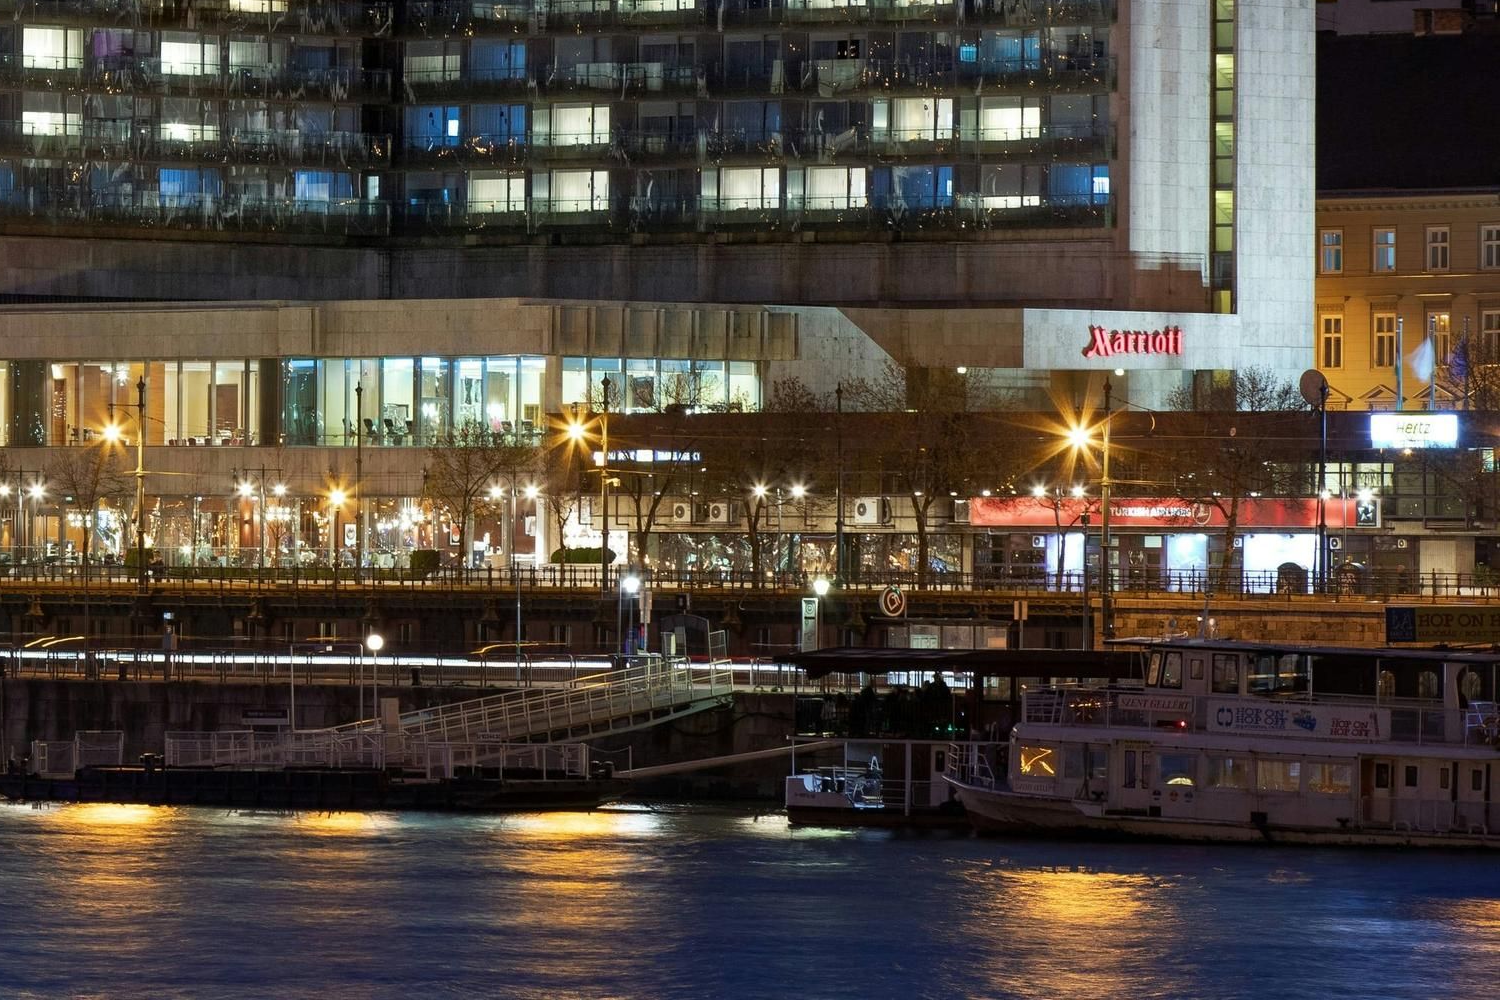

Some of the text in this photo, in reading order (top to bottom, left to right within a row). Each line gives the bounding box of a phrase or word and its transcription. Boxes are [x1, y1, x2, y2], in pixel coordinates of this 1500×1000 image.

[1083, 326, 1182, 357] Marriott
[1396, 422, 1431, 434] Hertz
[1110, 507, 1149, 517] TURKISH
[1418, 613, 1454, 627] HOP
[1458, 613, 1484, 627] ON
[1237, 707, 1262, 715] HOP
[1237, 715, 1261, 724] HOP
